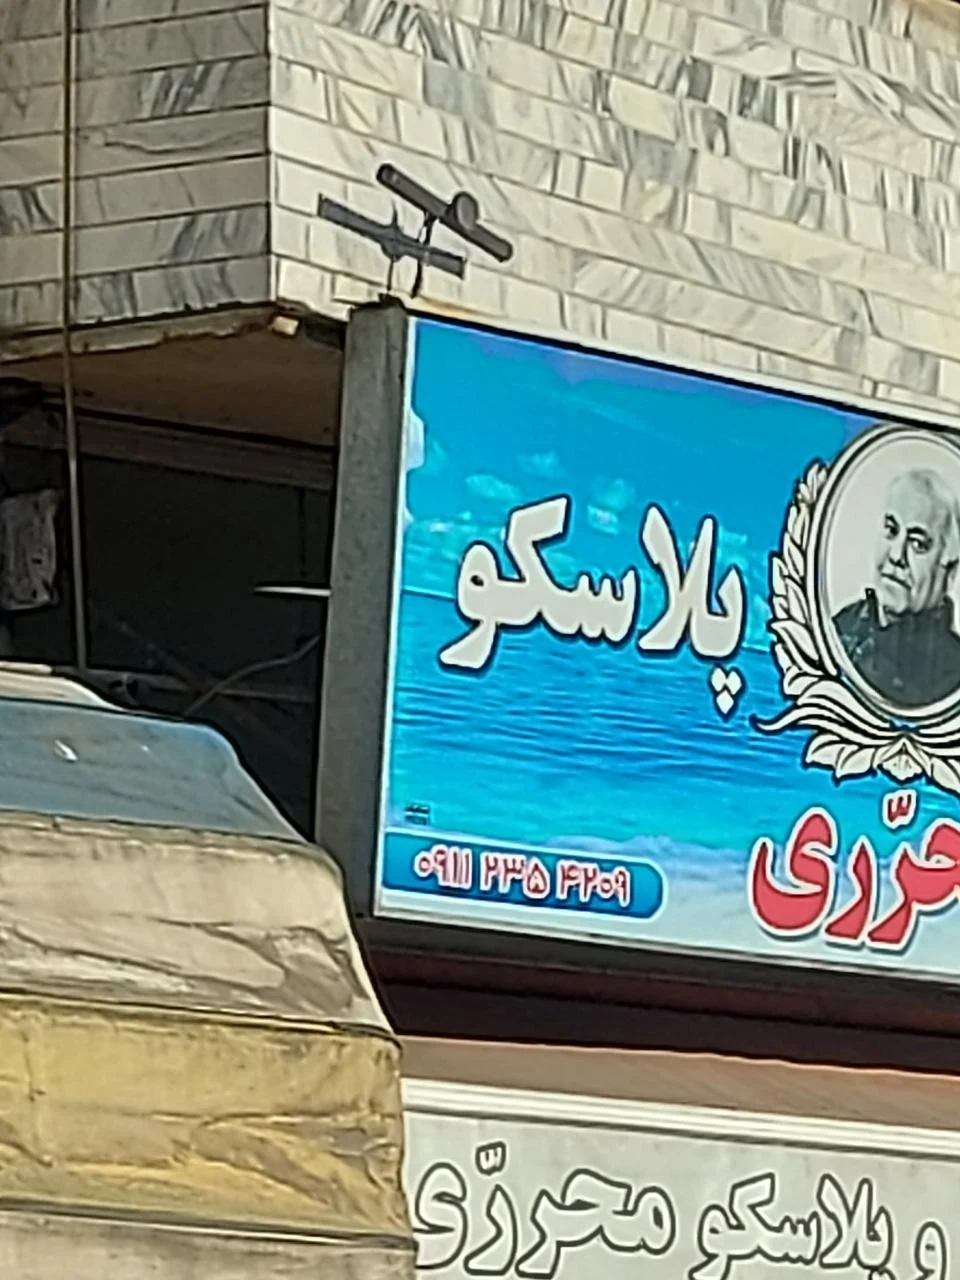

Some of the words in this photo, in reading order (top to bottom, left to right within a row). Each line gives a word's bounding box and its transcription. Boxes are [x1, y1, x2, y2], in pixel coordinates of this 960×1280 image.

[438, 495, 744, 715] پلاسکو
[414, 845, 472, 889] ۰۹۱۱
[480, 852, 550, 898] ۲۳۵
[556, 859, 630, 907] ۴۲۰۹
